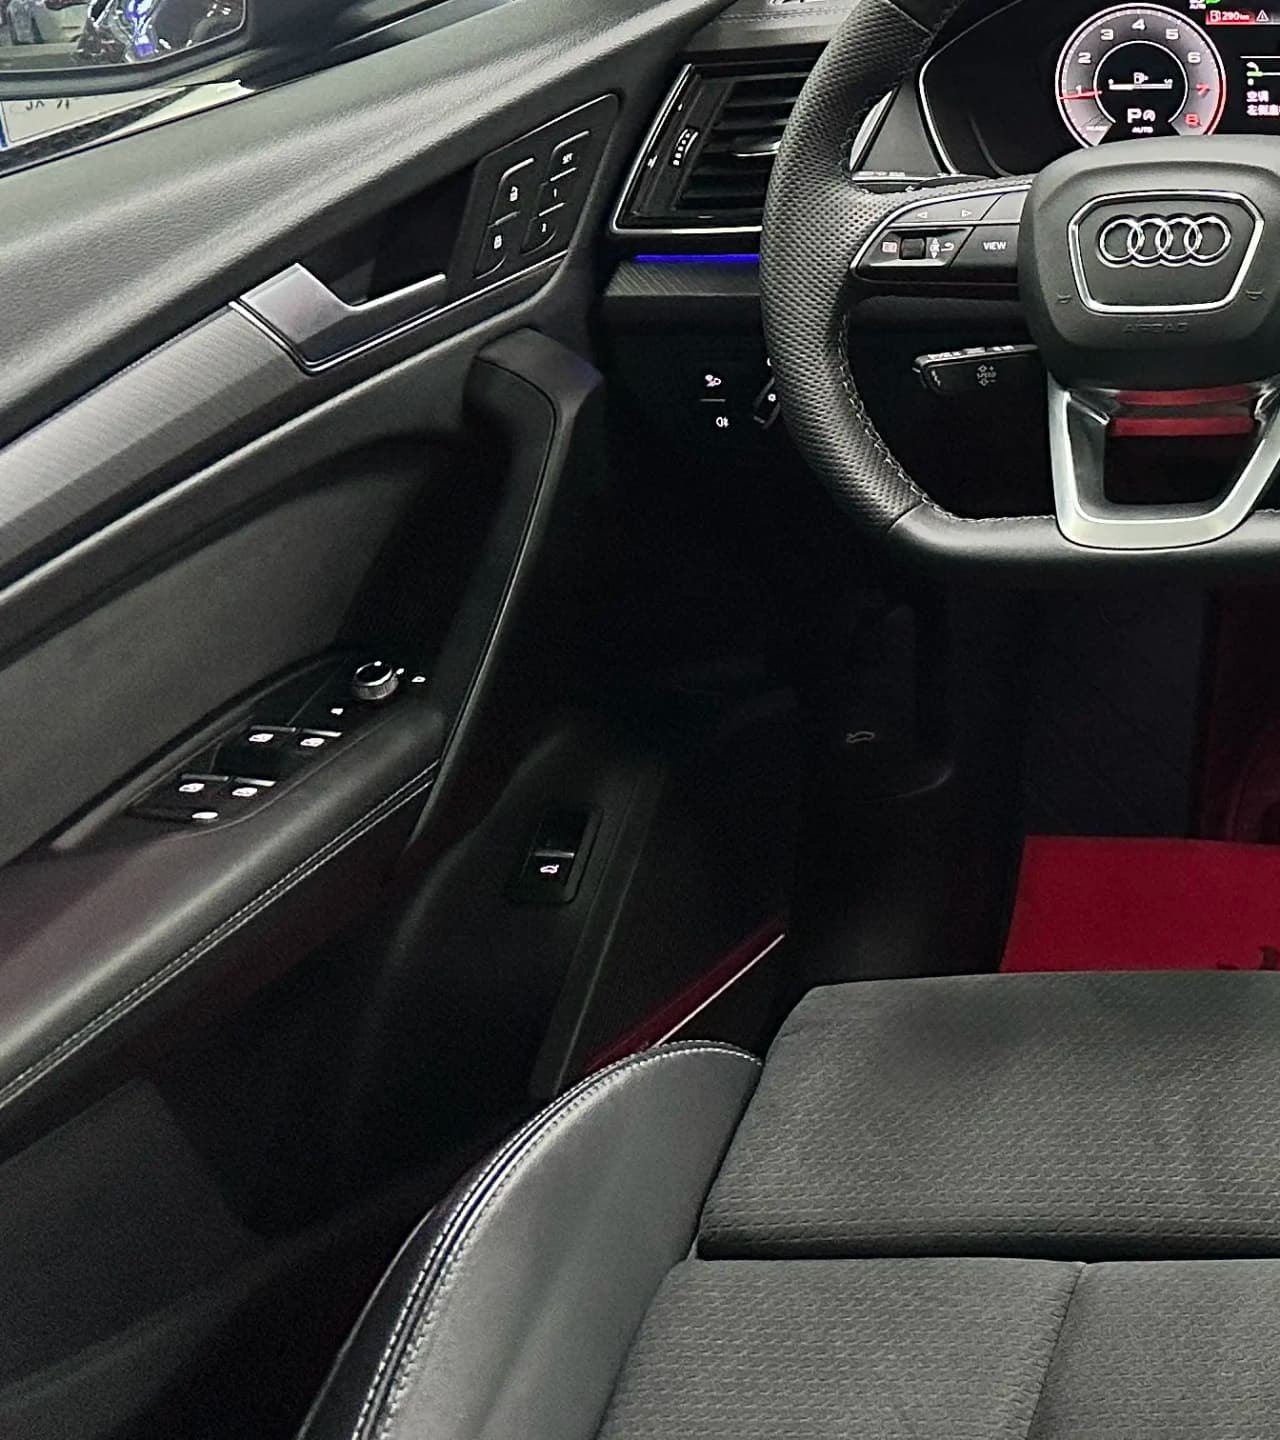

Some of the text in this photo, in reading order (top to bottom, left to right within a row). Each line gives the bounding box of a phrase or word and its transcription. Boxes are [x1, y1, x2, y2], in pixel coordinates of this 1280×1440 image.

[1131, 18, 1146, 31] 4
[1100, 28, 1115, 41] 3
[1165, 28, 1180, 40] 5
[1077, 51, 1093, 64] 2
[1186, 51, 1202, 64] 6
[1196, 83, 1210, 96] 7
[1126, 108, 1141, 124] P
[1184, 113, 1200, 127] 8
[983, 241, 1008, 251] VIEW
